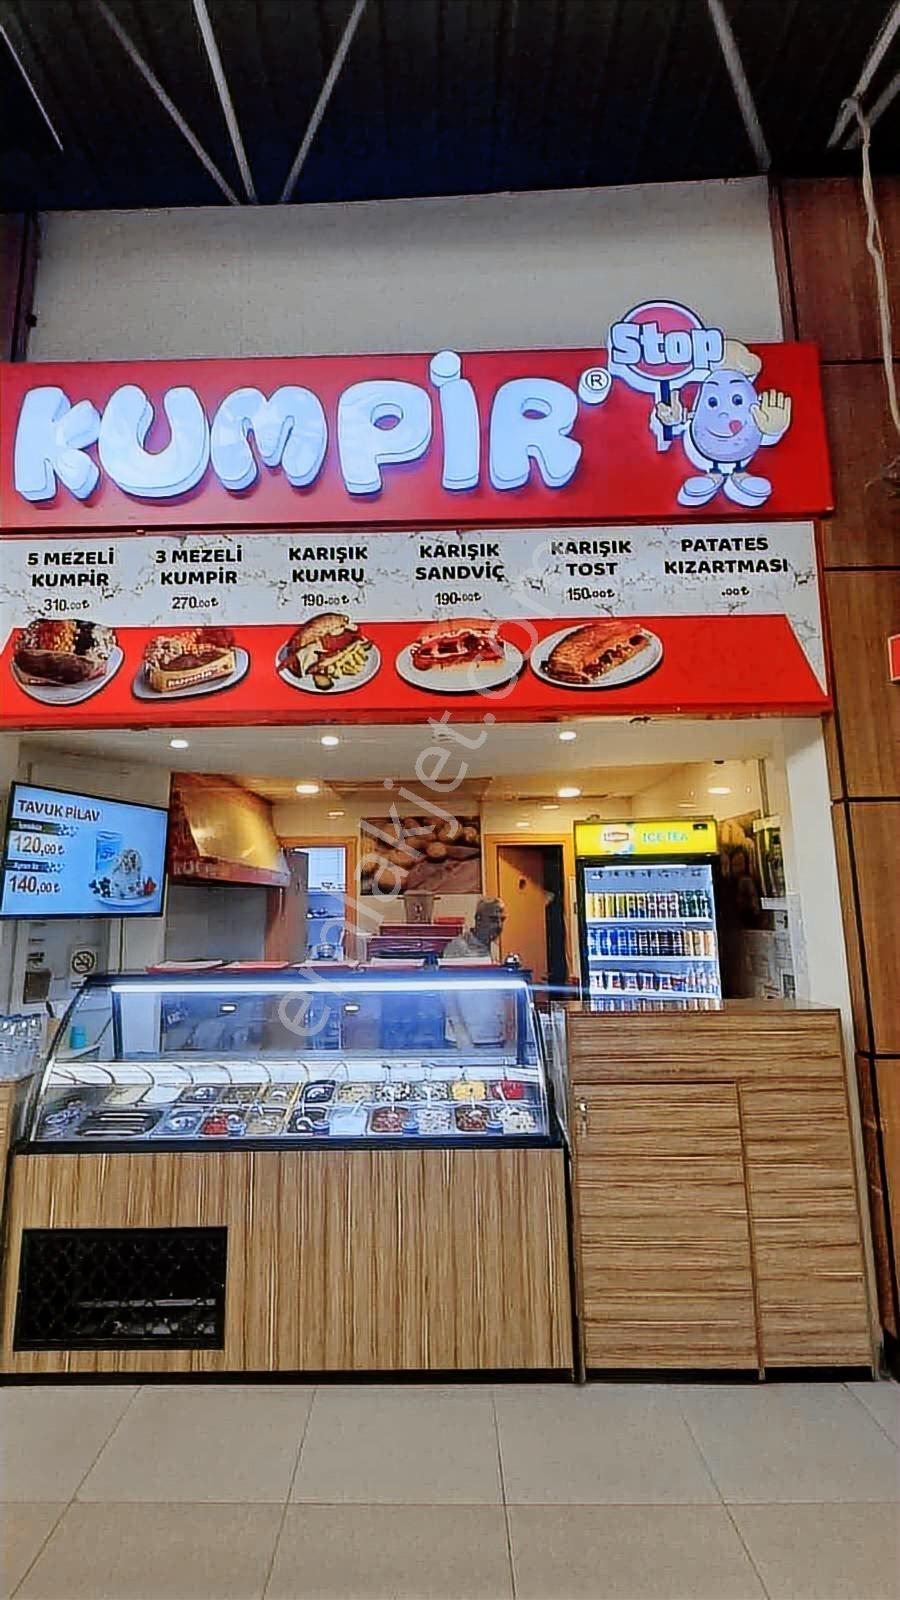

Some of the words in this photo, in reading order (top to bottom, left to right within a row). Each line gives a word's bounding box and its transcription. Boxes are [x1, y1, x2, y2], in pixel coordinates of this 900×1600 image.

[611, 321, 724, 370] Stop
[419, 543, 500, 561] KARIŞIK
[551, 540, 632, 557] KARIŞIK
[680, 537, 769, 552] PATATES
[27, 552, 39, 566] 5
[44, 547, 115, 565] MEZELİ
[155, 550, 166, 564] 3
[171, 544, 243, 563] MEZELİ
[288, 546, 368, 564] KARIŞIK
[415, 561, 505, 582] SANDVİÇ
[565, 562, 618, 576] TOST
[664, 558, 788, 574] KIZARTMASI
[31, 570, 110, 588] KUMPİR
[160, 567, 238, 585] KUMPİR
[292, 568, 365, 583] KUMRU
[18, 799, 63, 817] TAVUK
